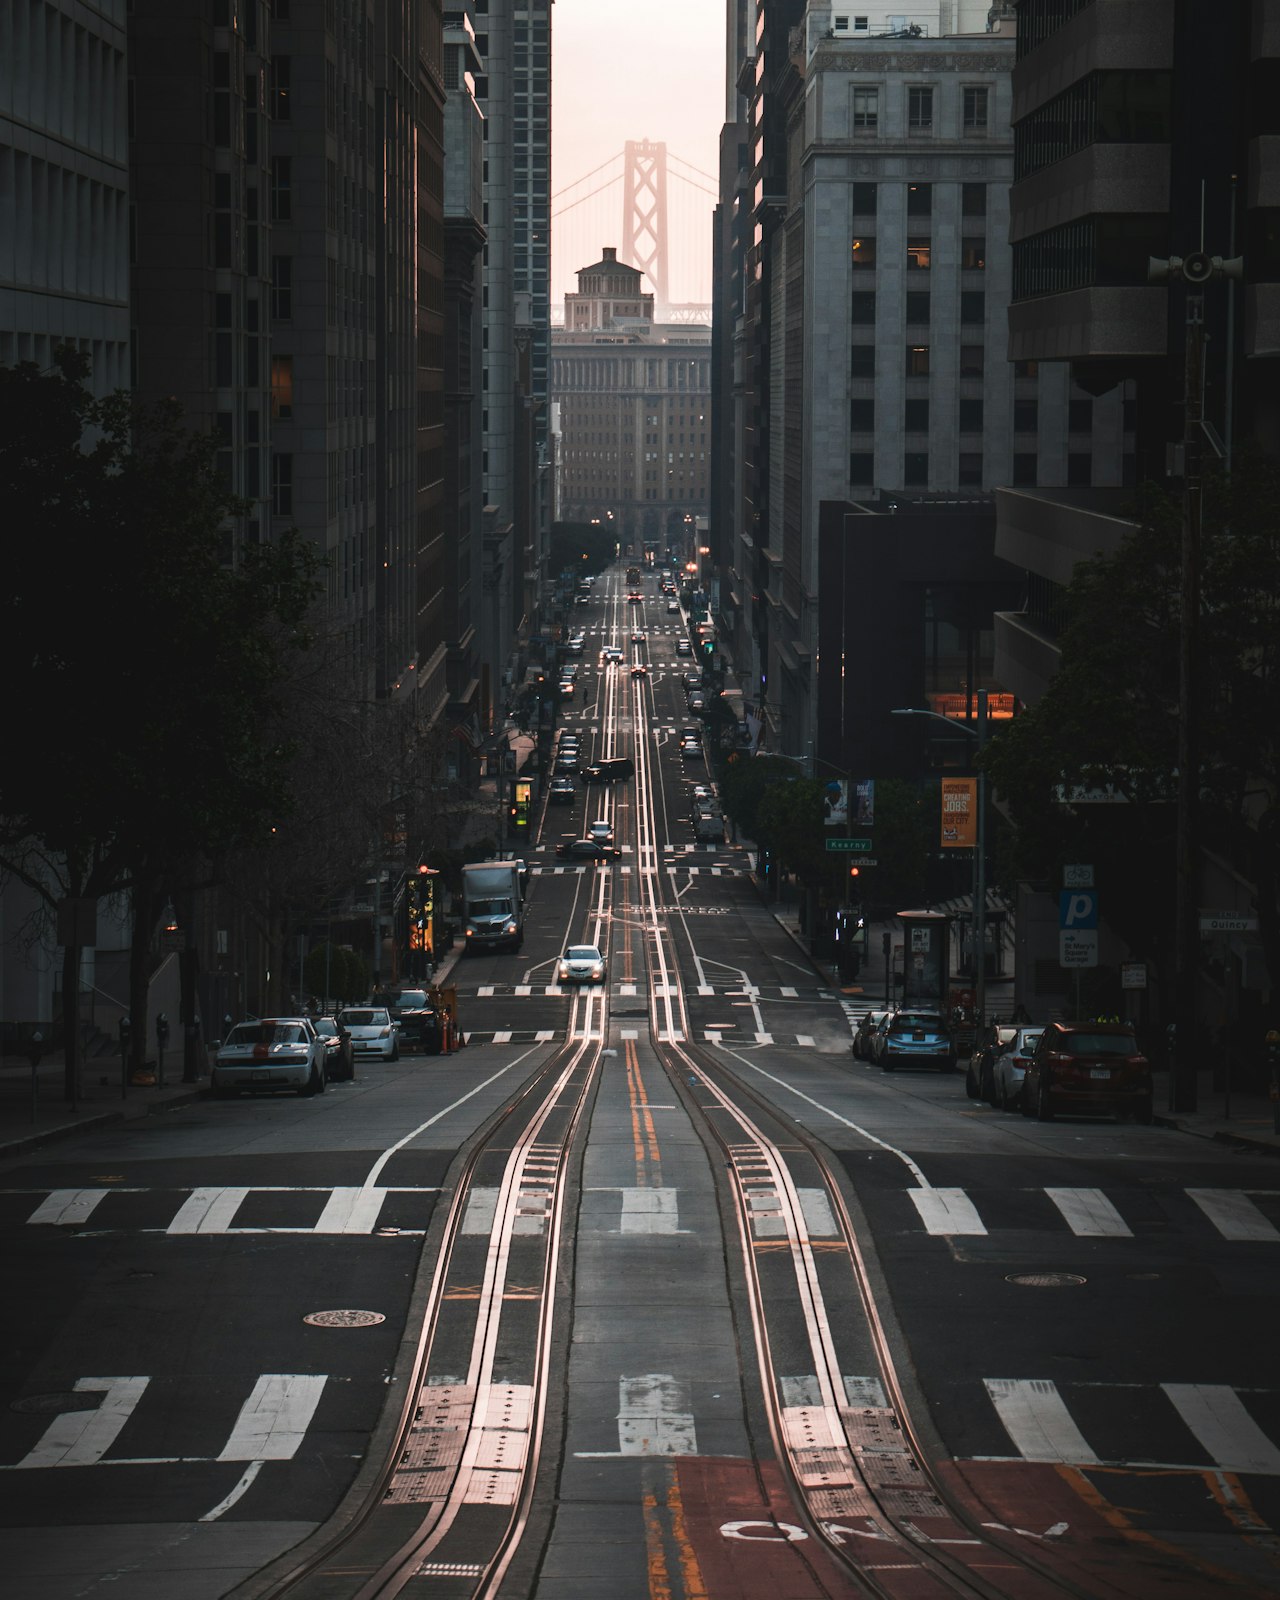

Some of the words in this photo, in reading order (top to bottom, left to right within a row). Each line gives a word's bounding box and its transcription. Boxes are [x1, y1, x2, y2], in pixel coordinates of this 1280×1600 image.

[944, 793, 971, 801] CREATING
[944, 801, 969, 812] JOBS.
[831, 841, 866, 849] Kearny
[1211, 920, 1248, 928] Quincy
[1073, 943, 1095, 951] Mary's
[719, 1519, 1070, 1544] ONLY
